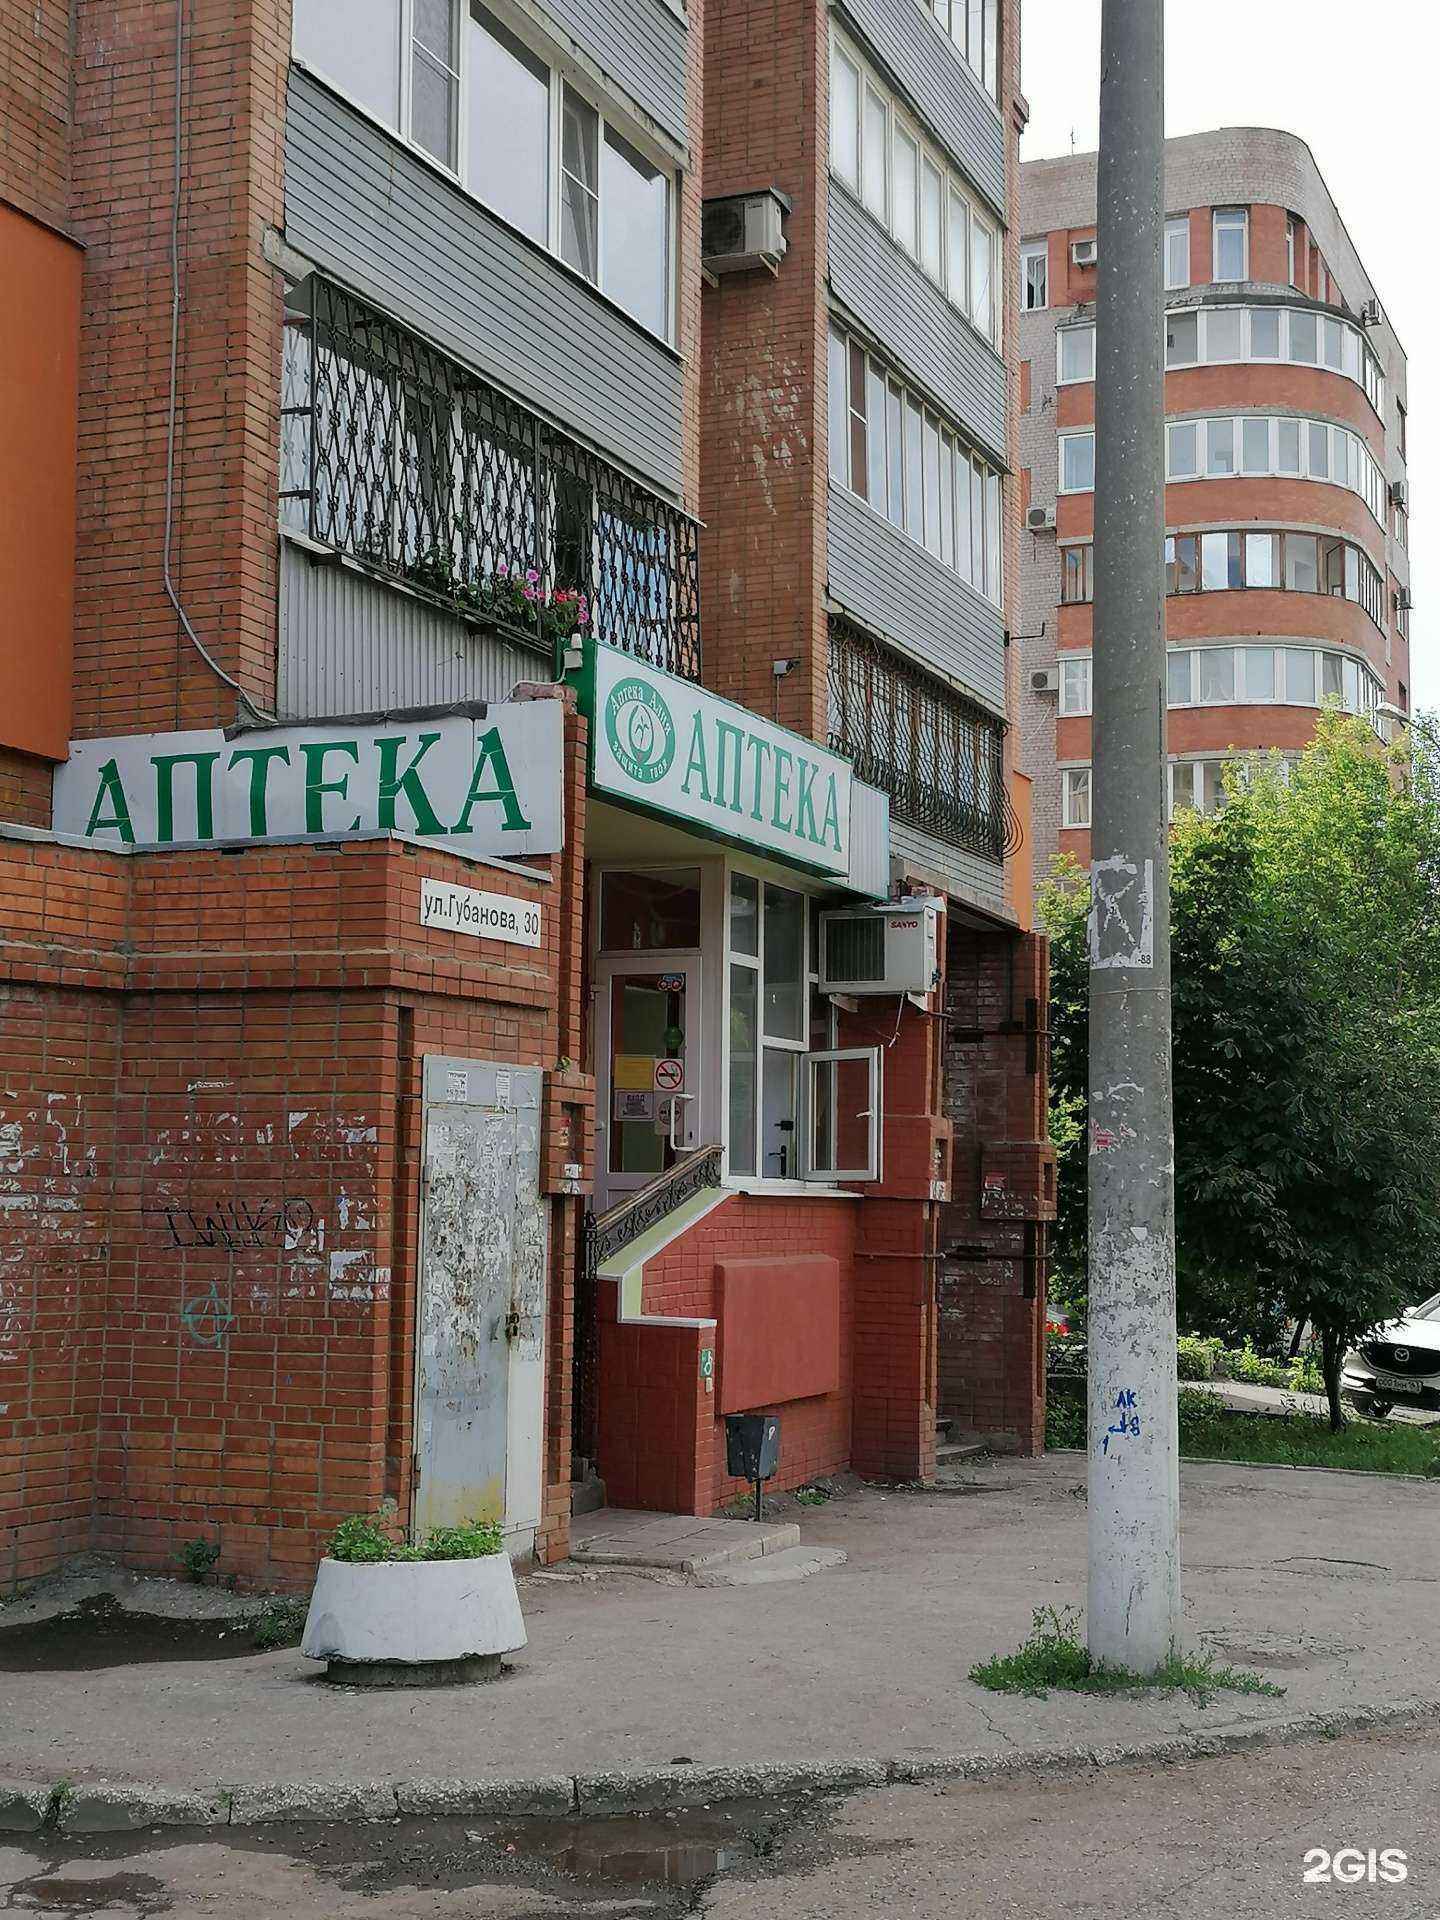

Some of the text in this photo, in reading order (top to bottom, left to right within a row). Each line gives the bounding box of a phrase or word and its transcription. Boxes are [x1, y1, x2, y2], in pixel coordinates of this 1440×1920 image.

[85, 726, 532, 844] АПТЕКА
[681, 708, 842, 853] АПТЕКА
[524, 911, 539, 935] 30
[890, 920, 919, 929] SANYO
